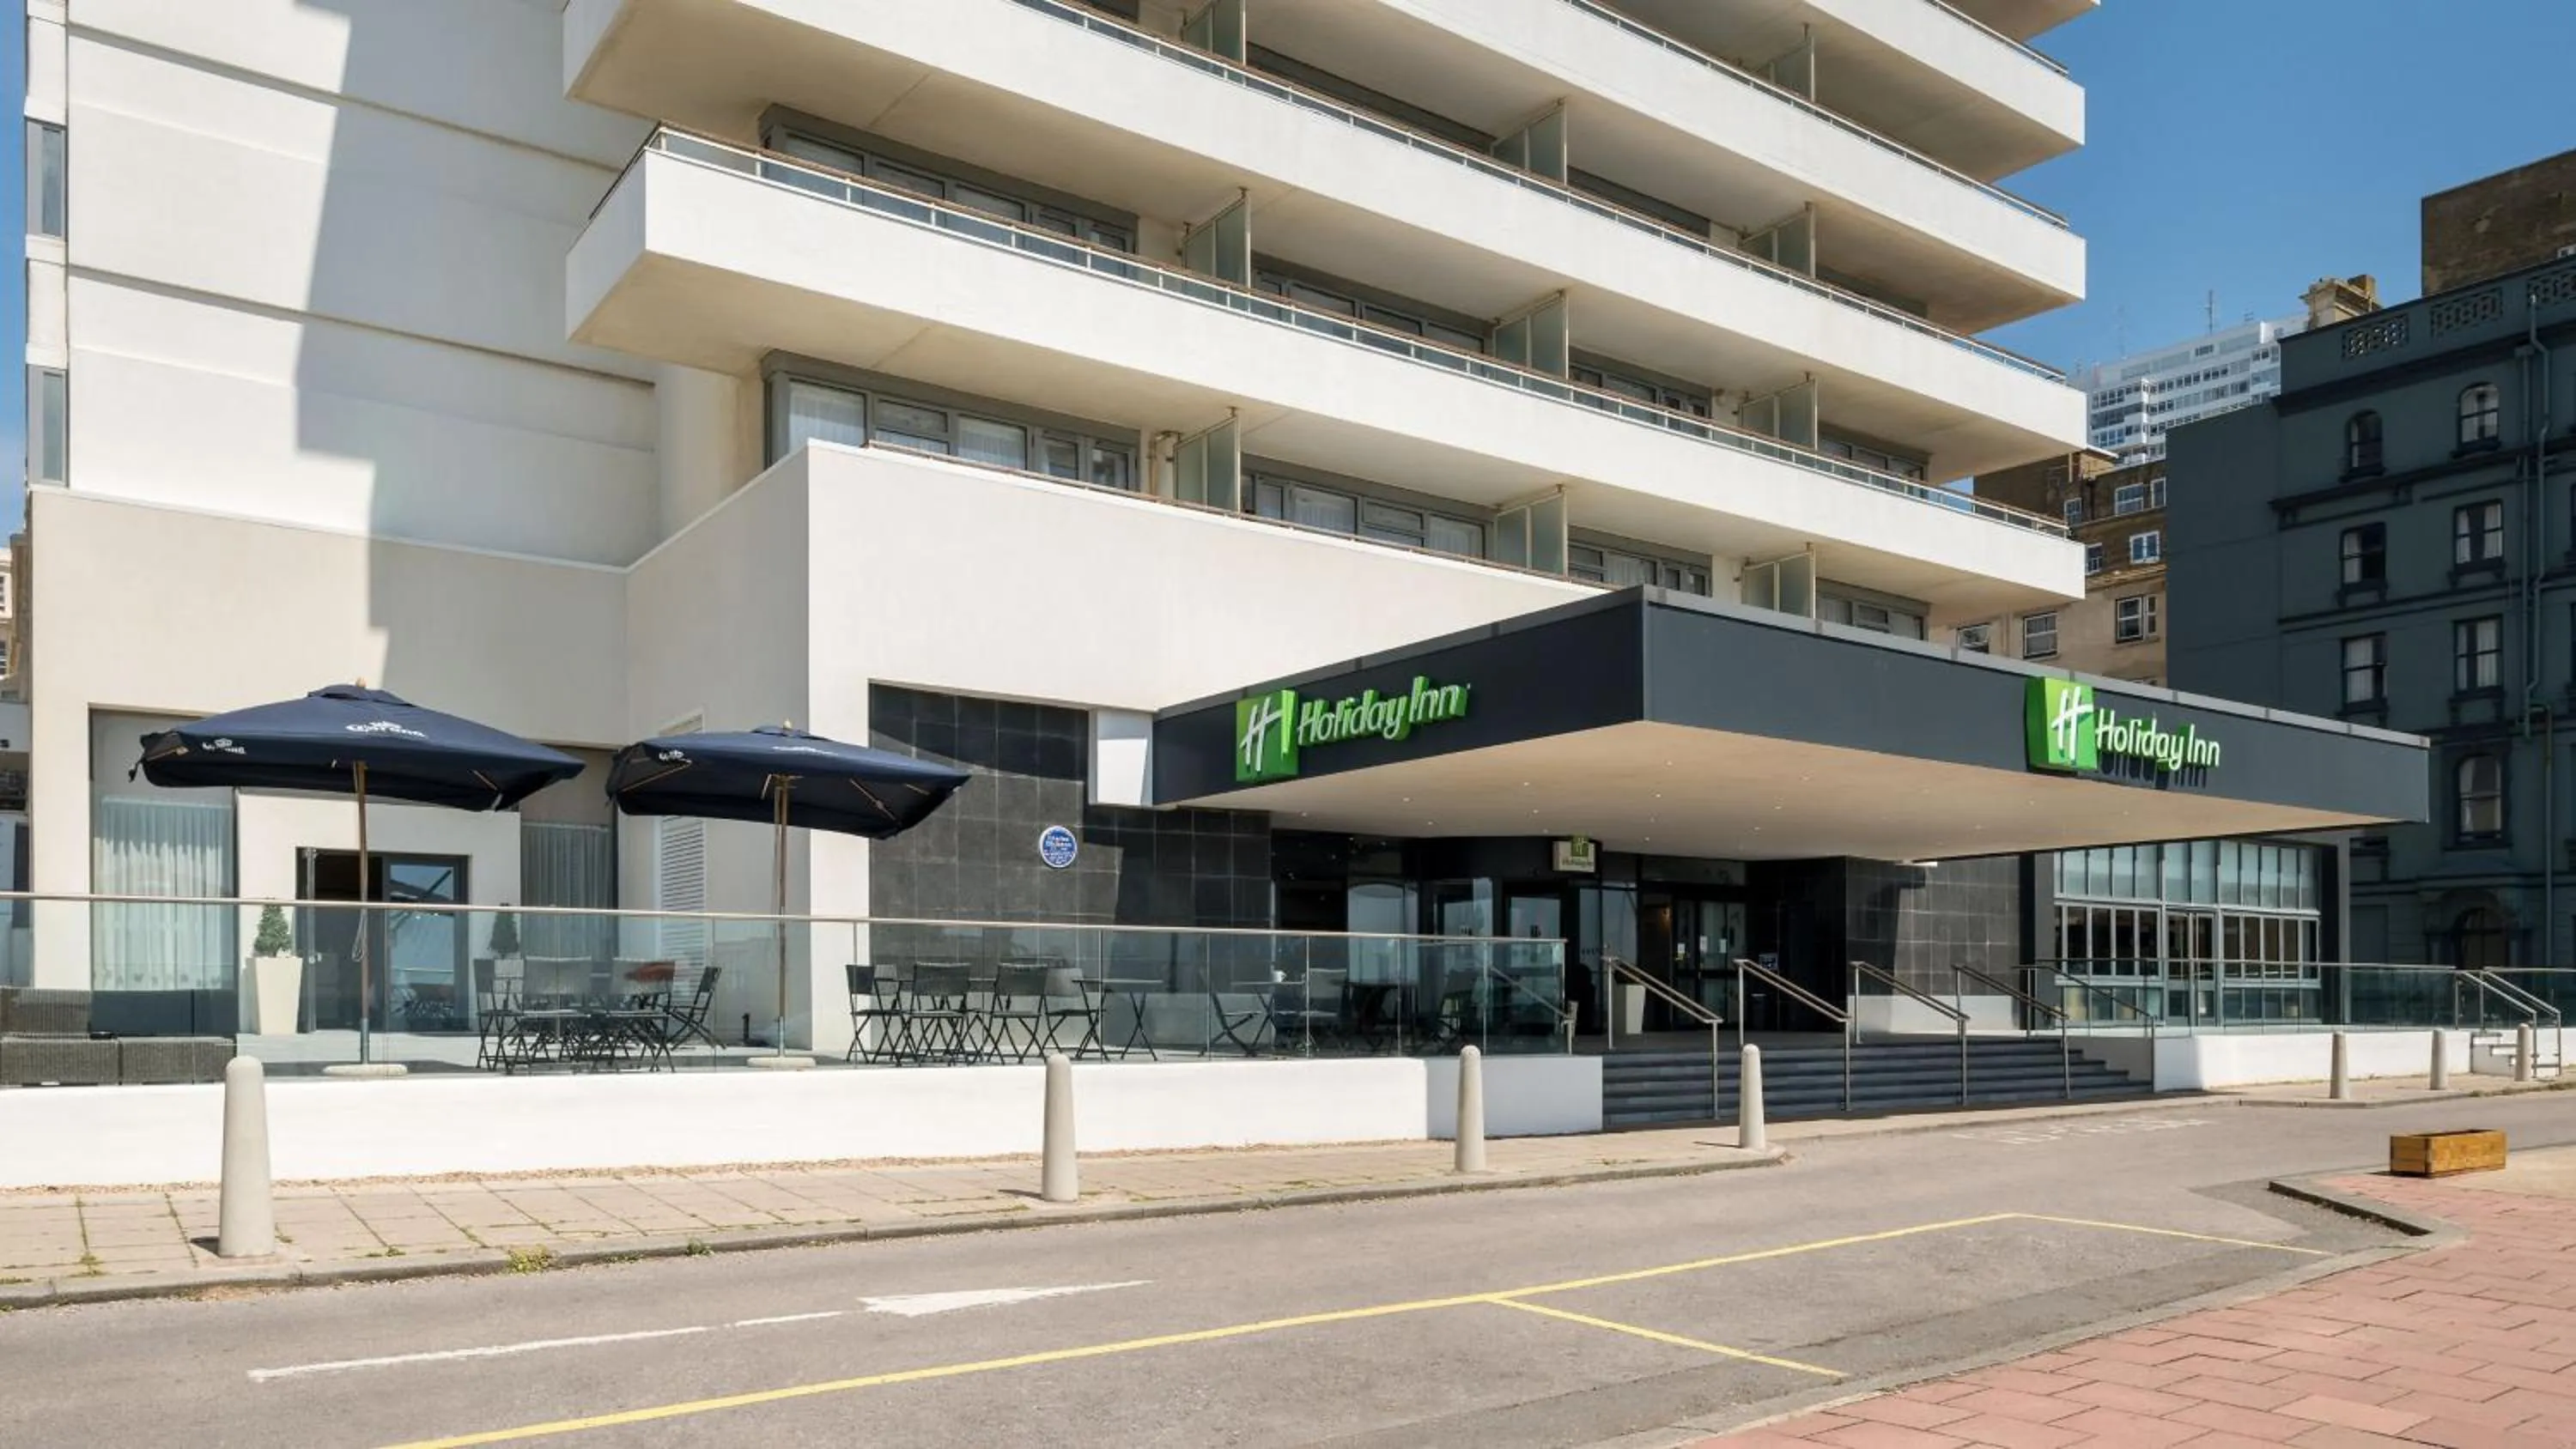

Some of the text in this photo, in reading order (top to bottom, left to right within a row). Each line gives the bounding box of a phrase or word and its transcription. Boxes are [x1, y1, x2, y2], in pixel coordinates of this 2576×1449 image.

[1297, 689, 1409, 745] Holiday
[1409, 676, 1467, 724] Inn
[2096, 707, 2184, 771] Holiday
[2187, 724, 2221, 767] Inn
